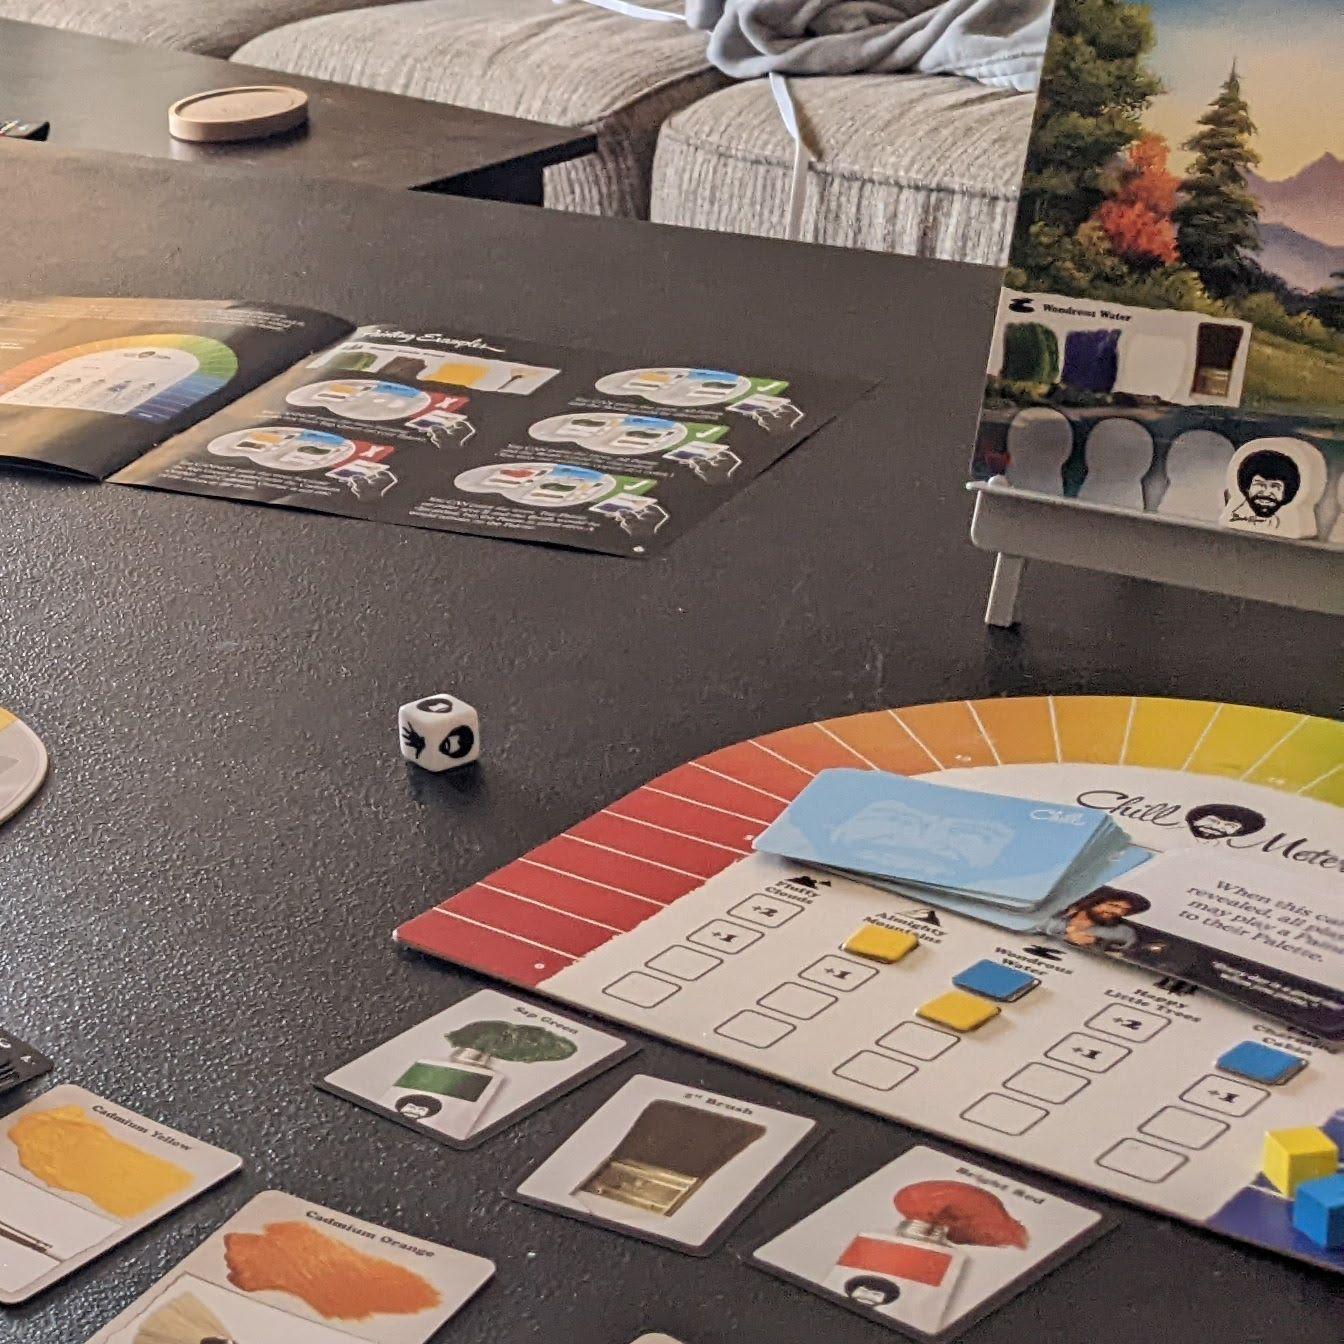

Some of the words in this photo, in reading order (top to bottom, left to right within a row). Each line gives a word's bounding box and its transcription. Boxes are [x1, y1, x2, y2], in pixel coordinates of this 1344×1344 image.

[1100, 310, 1132, 321] Water
[1030, 809, 1087, 826] Chill
[1076, 790, 1180, 827] Chill
[765, 886, 813, 905] Clouds
[775, 881, 821, 898] Fluffy
[1217, 880, 1272, 904] When
[1275, 900, 1313, 917] this
[751, 905, 779, 918] +2
[1187, 887, 1273, 919] revealed,
[1277, 915, 1307, 927] all
[1187, 901, 1232, 918] may
[863, 916, 943, 945] Mountins
[875, 912, 949, 937] Almighty
[1178, 910, 1200, 921] to
[1202, 918, 1251, 936] their
[712, 931, 739, 944] +1
[994, 946, 1074, 976] Wondrous
[823, 966, 852, 981] +1
[1156, 1004, 1202, 1023] Trees
[540, 1016, 579, 1035] Green
[1112, 1017, 1143, 1031] +2
[1072, 1046, 1102, 1059] +1
[1208, 1089, 1240, 1103] +1
[705, 1097, 753, 1115] Brush
[92, 1105, 148, 1134] Cadmium
[151, 1130, 192, 1150] Yellow
[1013, 1189, 1045, 1205] Red
[306, 1210, 376, 1239] Cadmium
[380, 1236, 435, 1257] Orange
